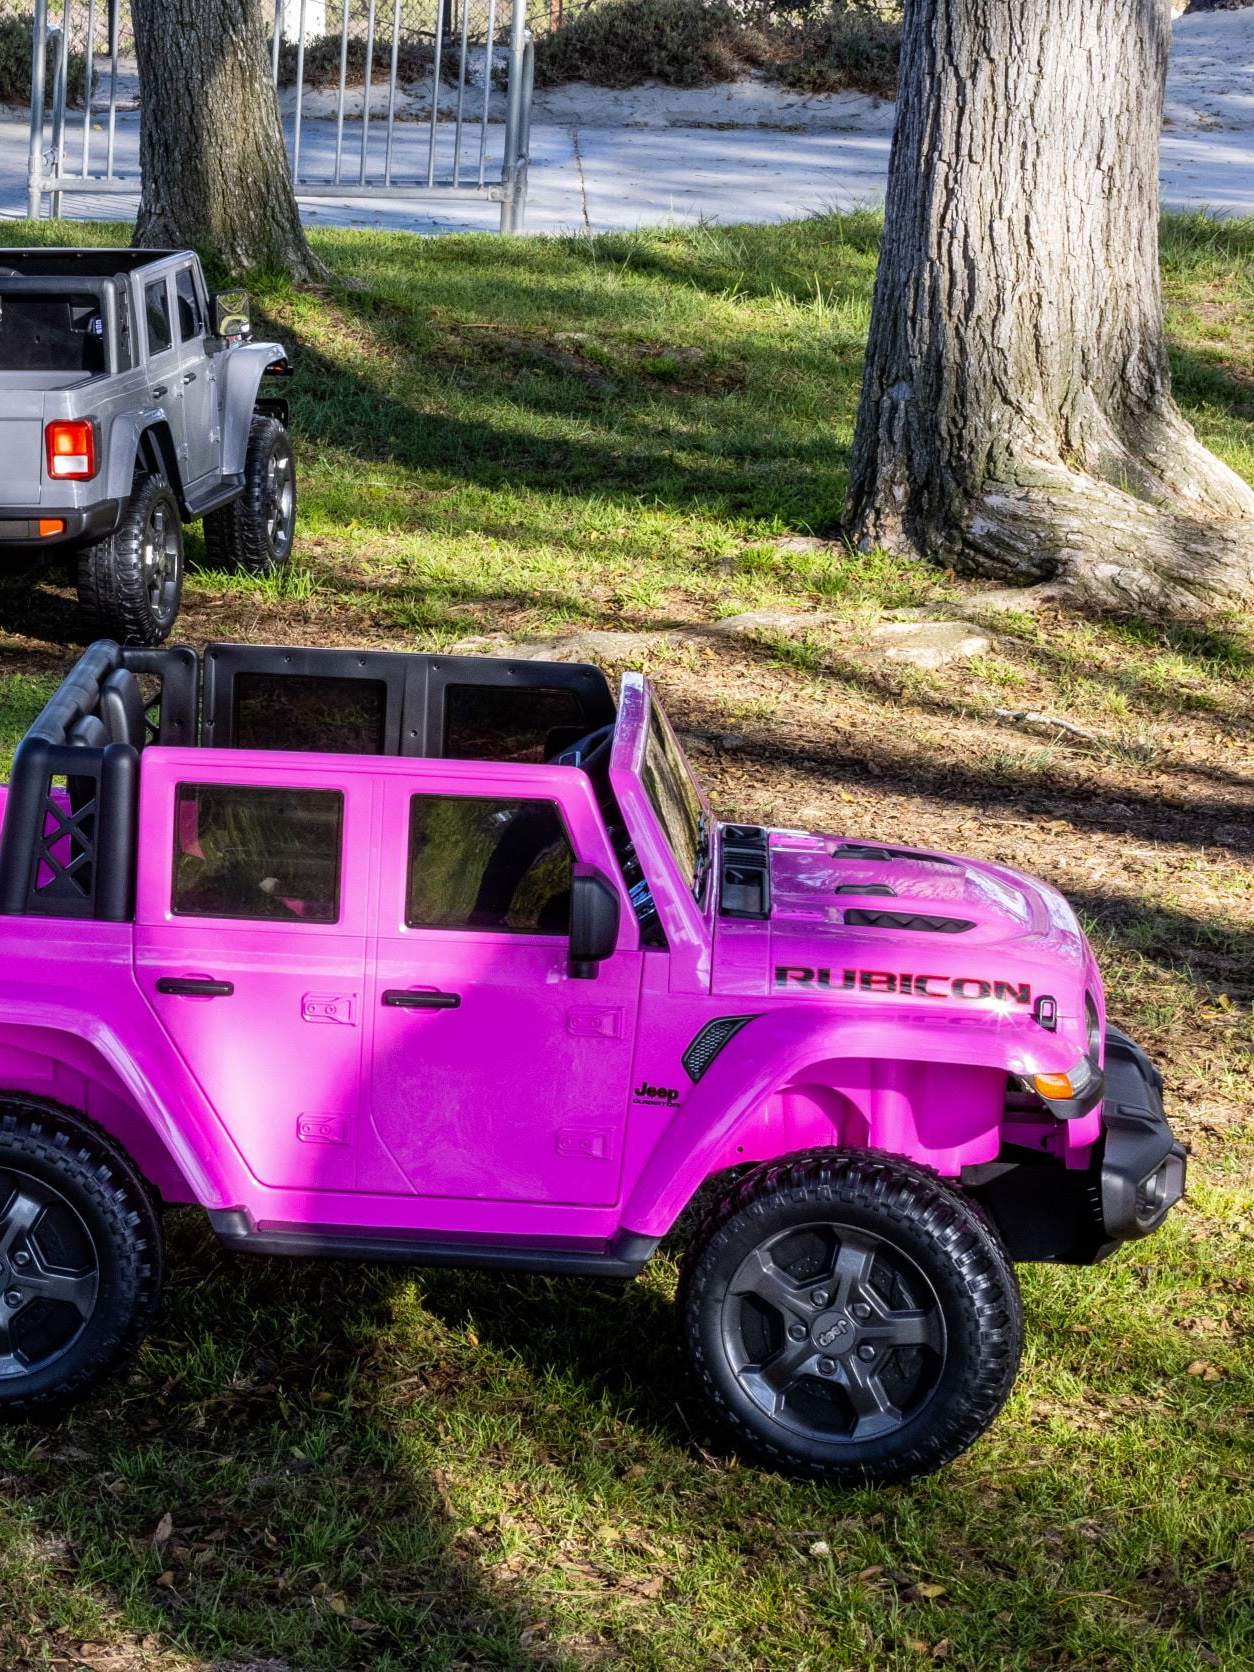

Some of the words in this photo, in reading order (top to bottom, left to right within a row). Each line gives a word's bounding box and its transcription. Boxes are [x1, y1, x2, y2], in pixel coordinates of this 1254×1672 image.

[774, 966, 1031, 1006] RUBICON
[634, 1081, 679, 1104] Jeep
[819, 1319, 847, 1346] Jeep
